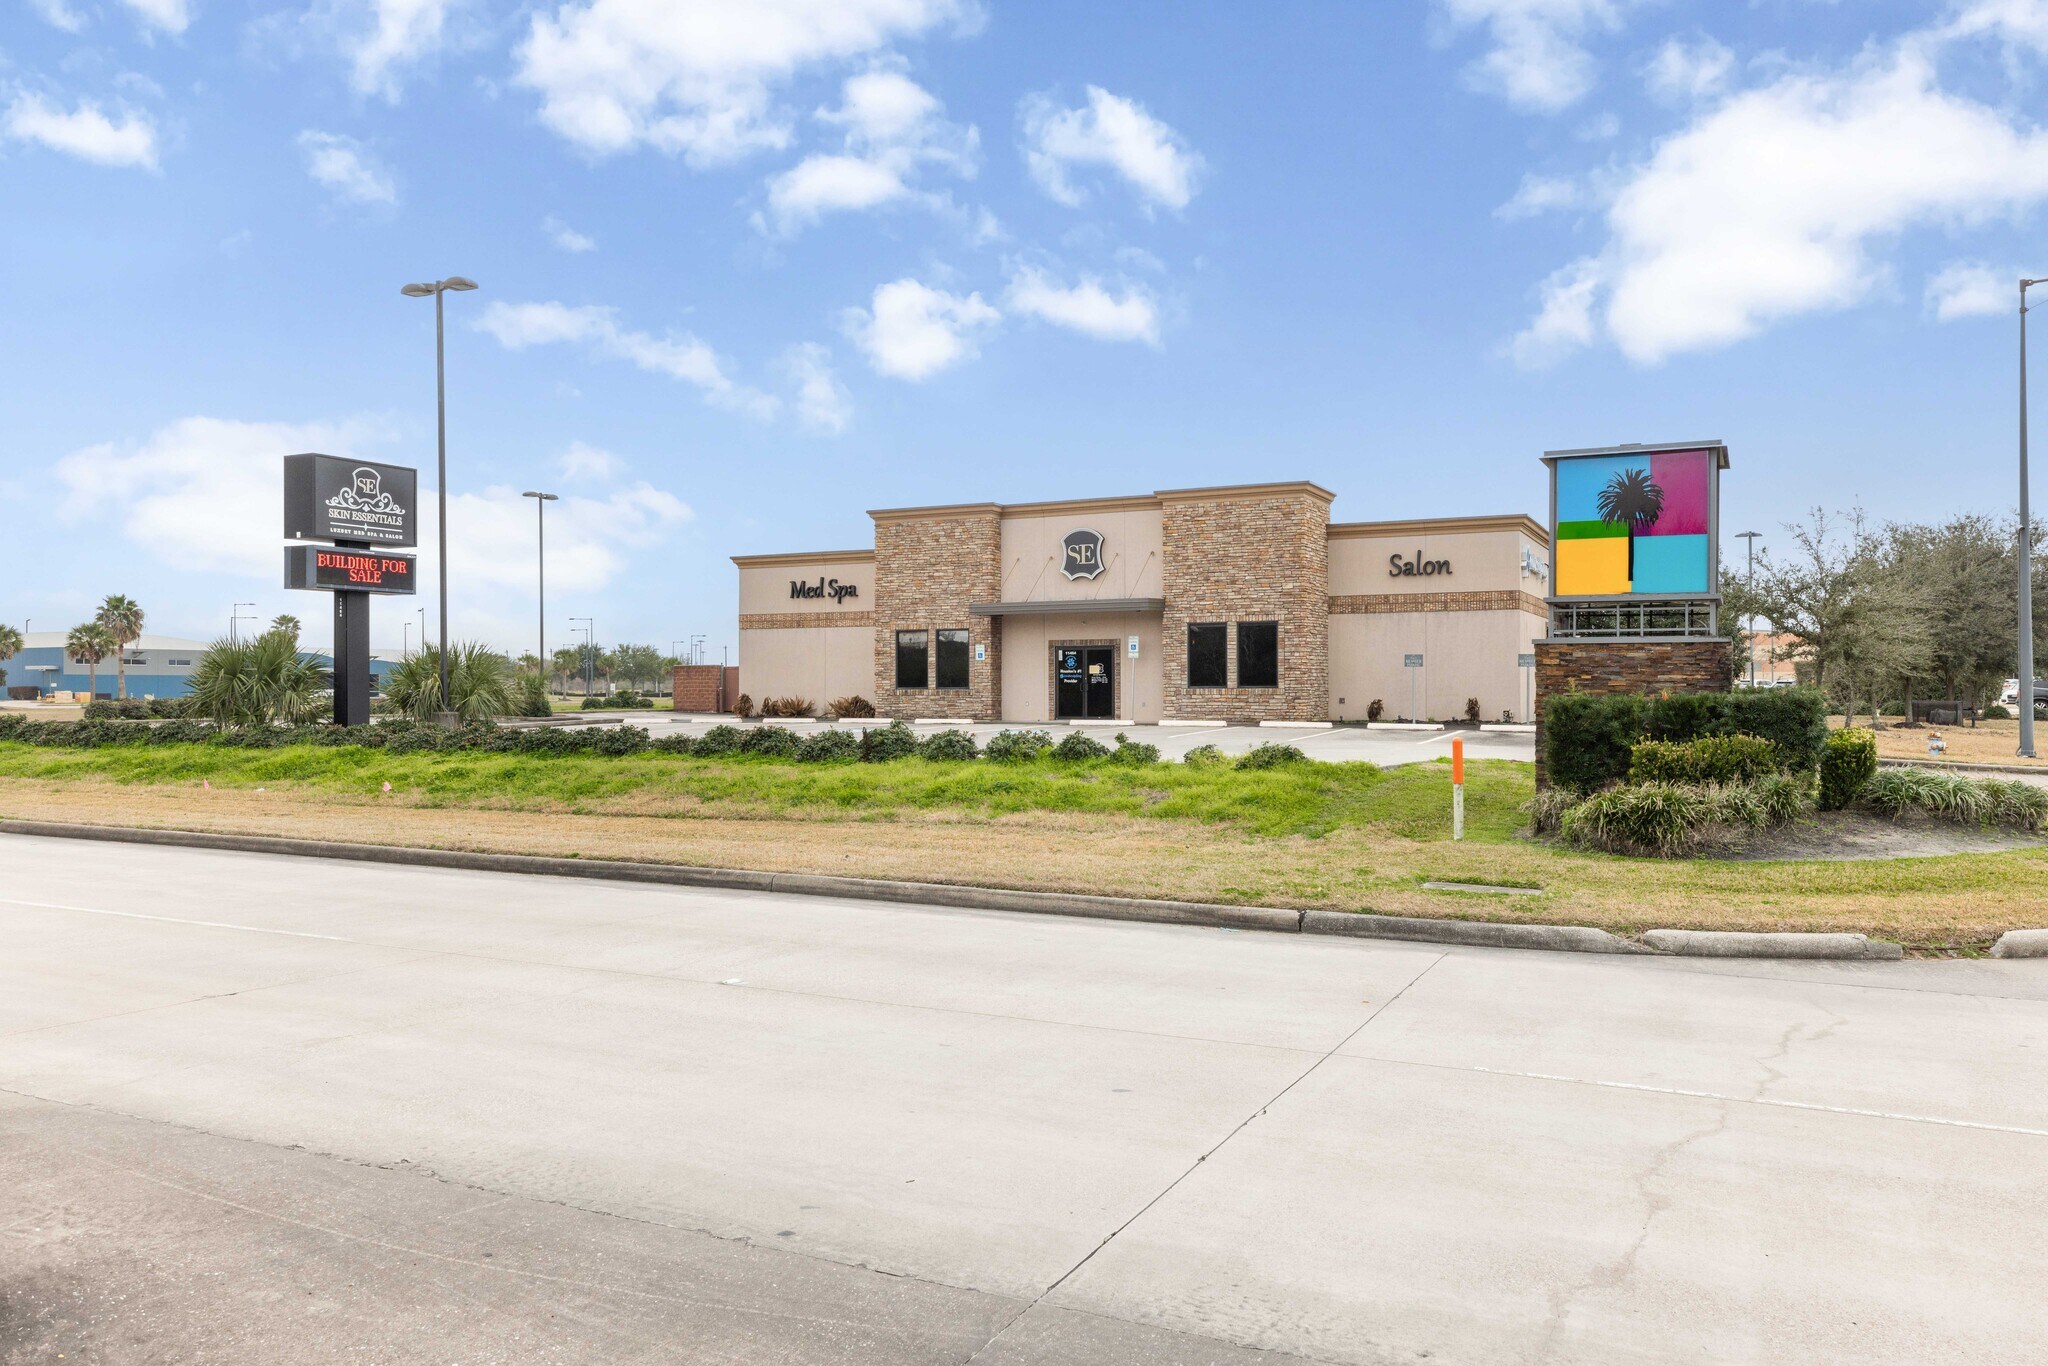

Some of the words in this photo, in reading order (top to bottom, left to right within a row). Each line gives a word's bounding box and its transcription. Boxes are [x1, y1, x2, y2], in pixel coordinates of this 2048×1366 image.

[357, 477, 376, 495] SE
[328, 508, 351, 520] SKIN
[351, 511, 402, 526] ESSENTIALS
[330, 527, 351, 535] LUXURY
[318, 553, 378, 570] BUILDING
[382, 560, 407, 574] FOR
[1067, 543, 1095, 565] SE
[1389, 549, 1453, 577] Salon
[350, 569, 382, 583] SALE
[789, 576, 826, 599] Med
[827, 578, 859, 605] Spa
